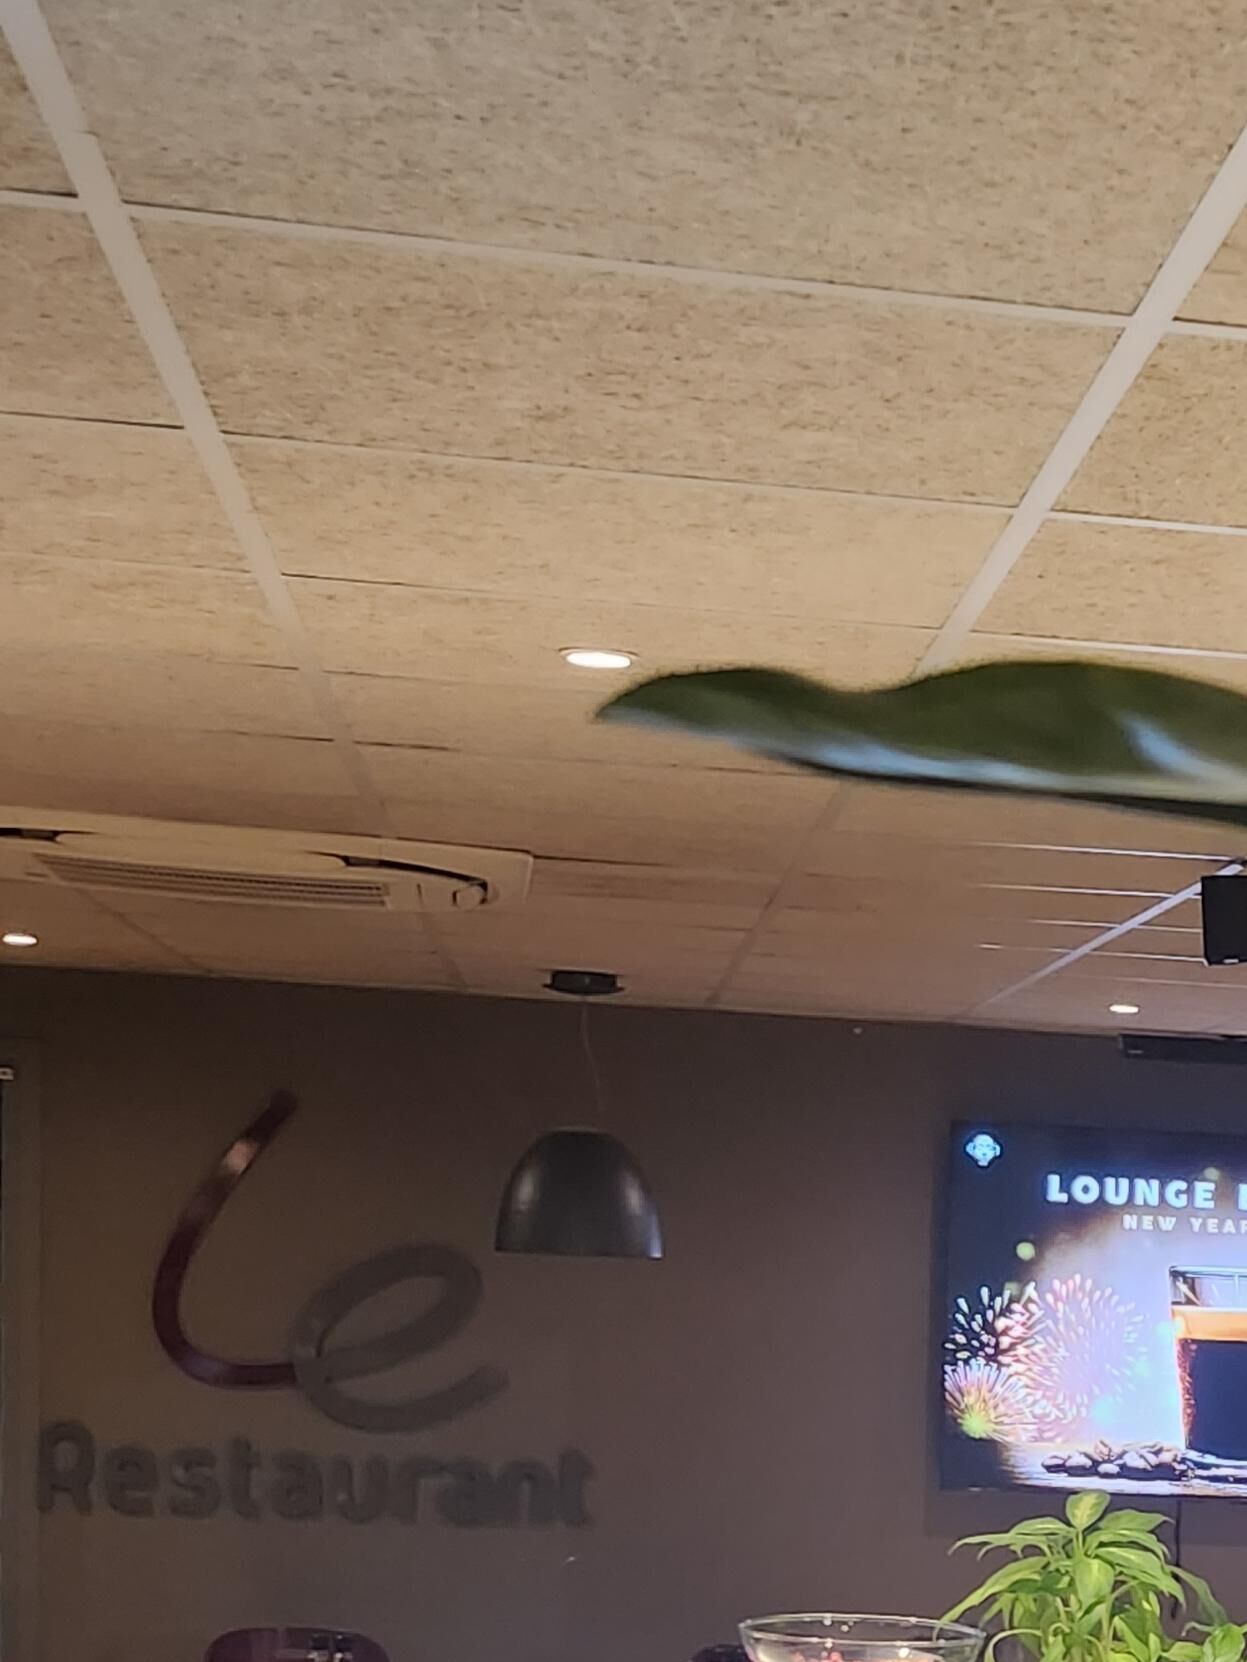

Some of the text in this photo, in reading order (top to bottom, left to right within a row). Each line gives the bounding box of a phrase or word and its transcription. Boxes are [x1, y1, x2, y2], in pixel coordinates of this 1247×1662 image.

[1046, 1173, 1217, 1209] LOUNGE
[1122, 1213, 1177, 1232] NEW
[36, 1418, 595, 1528] Restaurant
